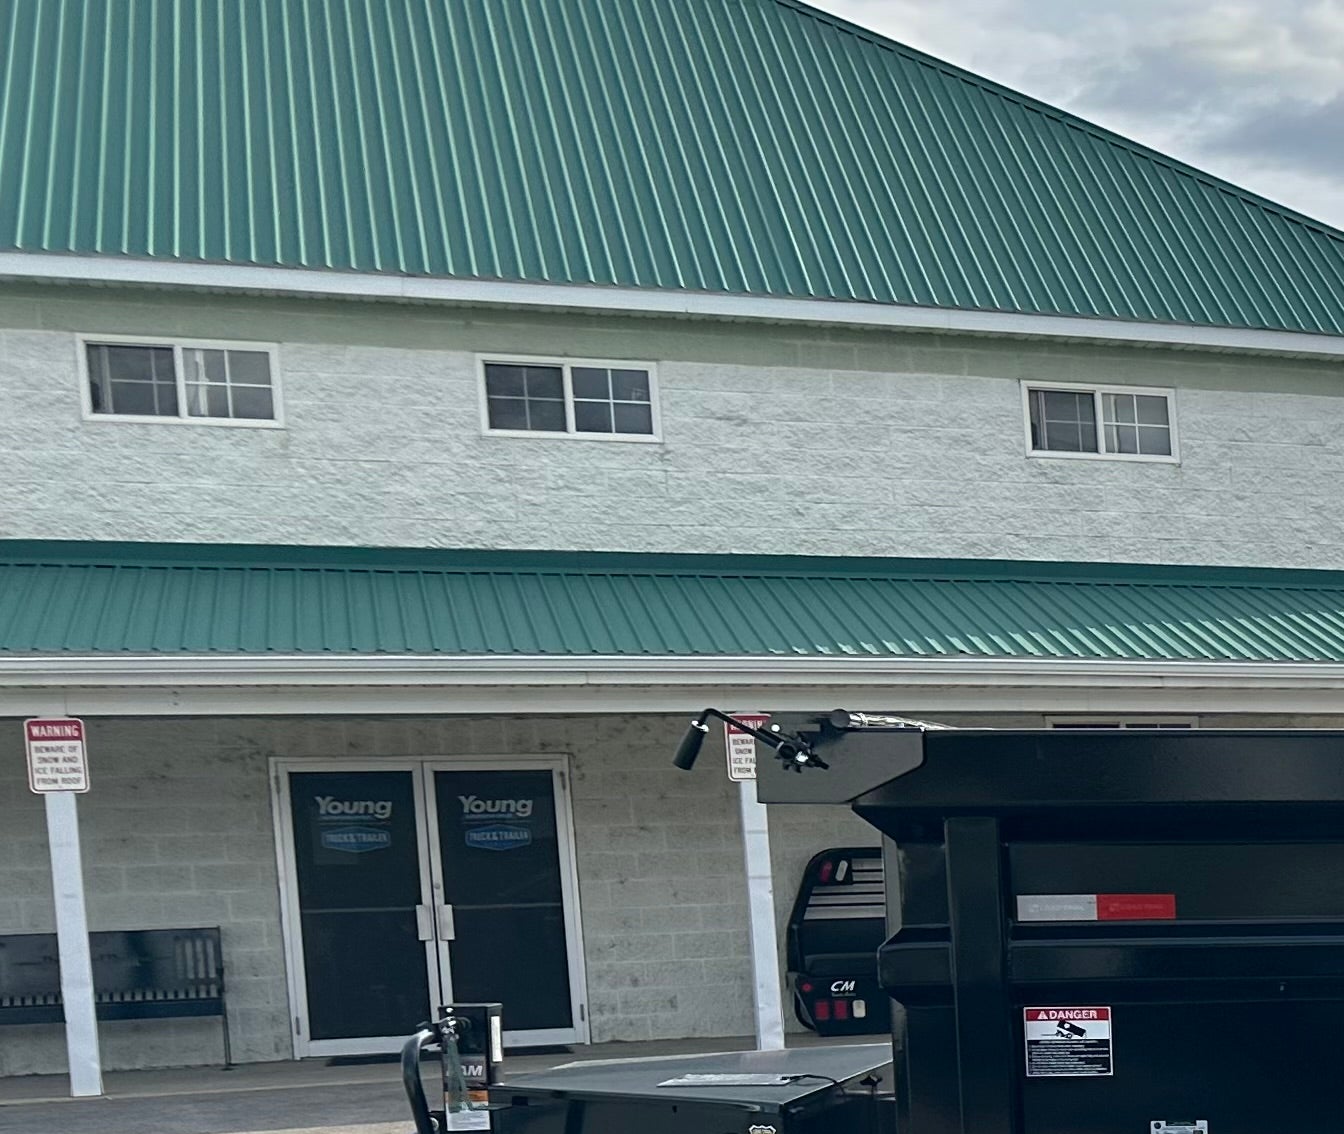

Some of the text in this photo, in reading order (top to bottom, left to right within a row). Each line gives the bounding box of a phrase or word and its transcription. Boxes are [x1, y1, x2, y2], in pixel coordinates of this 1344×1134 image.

[30, 725, 79, 737] WARNING
[34, 745, 65, 753] BEWARE
[315, 796, 392, 818] Young
[458, 795, 533, 817] Young
[830, 980, 856, 992] CM
[1049, 1010, 1098, 1020] DANGER
